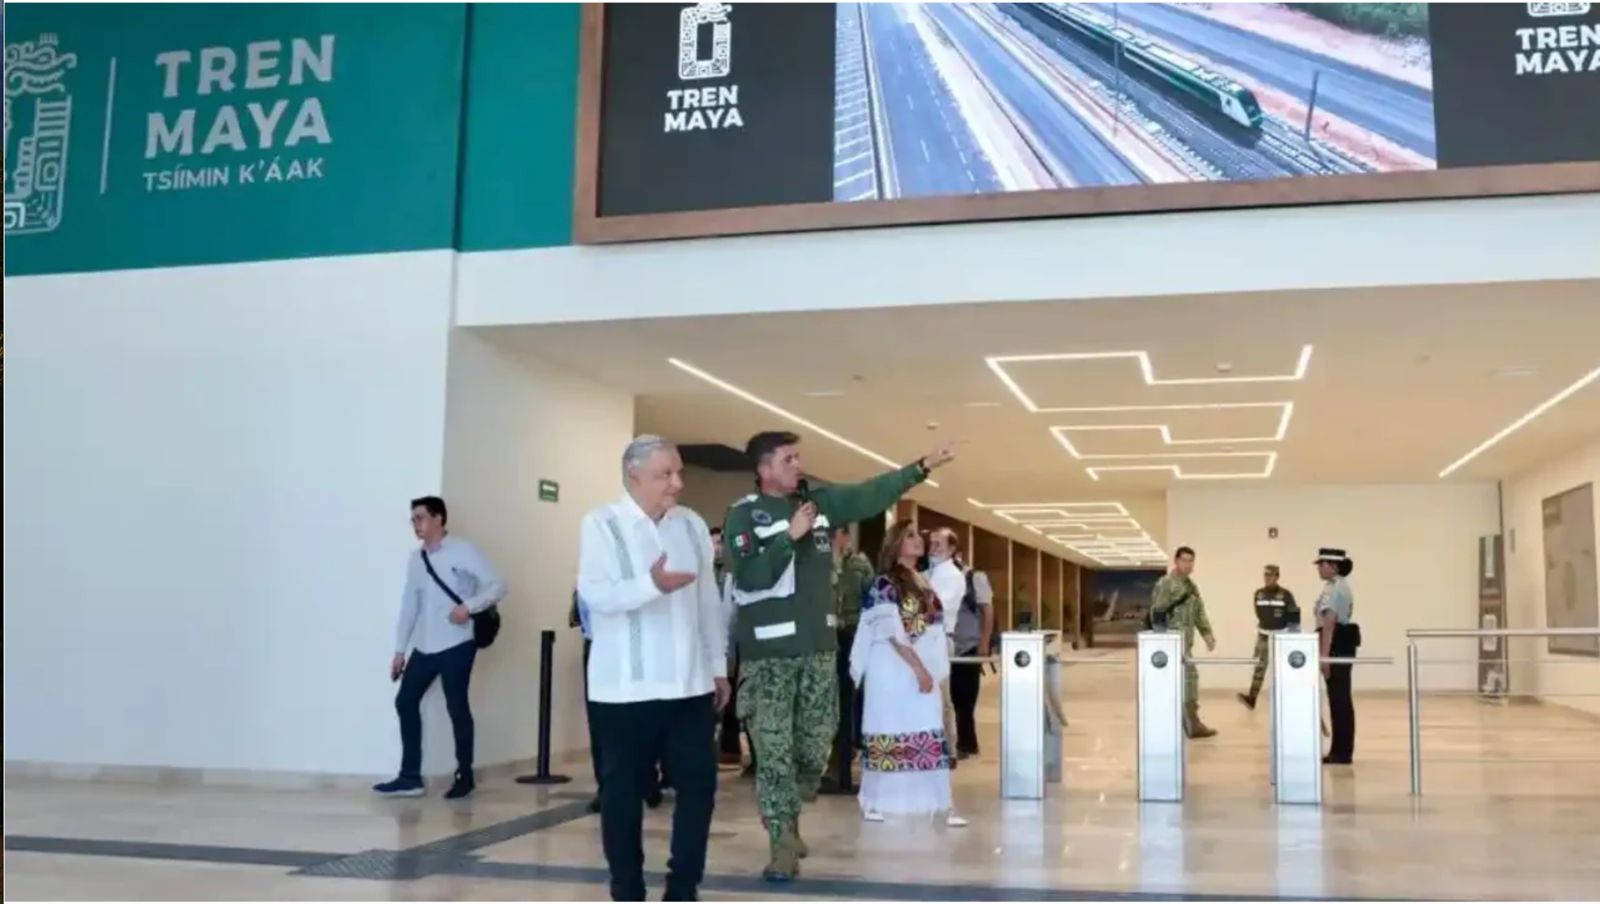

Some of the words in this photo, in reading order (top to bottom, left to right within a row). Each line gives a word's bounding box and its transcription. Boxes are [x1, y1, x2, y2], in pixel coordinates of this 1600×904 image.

[1515, 23, 1600, 50] TREN
[155, 34, 335, 98] TREN
[666, 84, 739, 110] TREN
[144, 97, 332, 158] MAYA
[664, 107, 744, 133] MAYA
